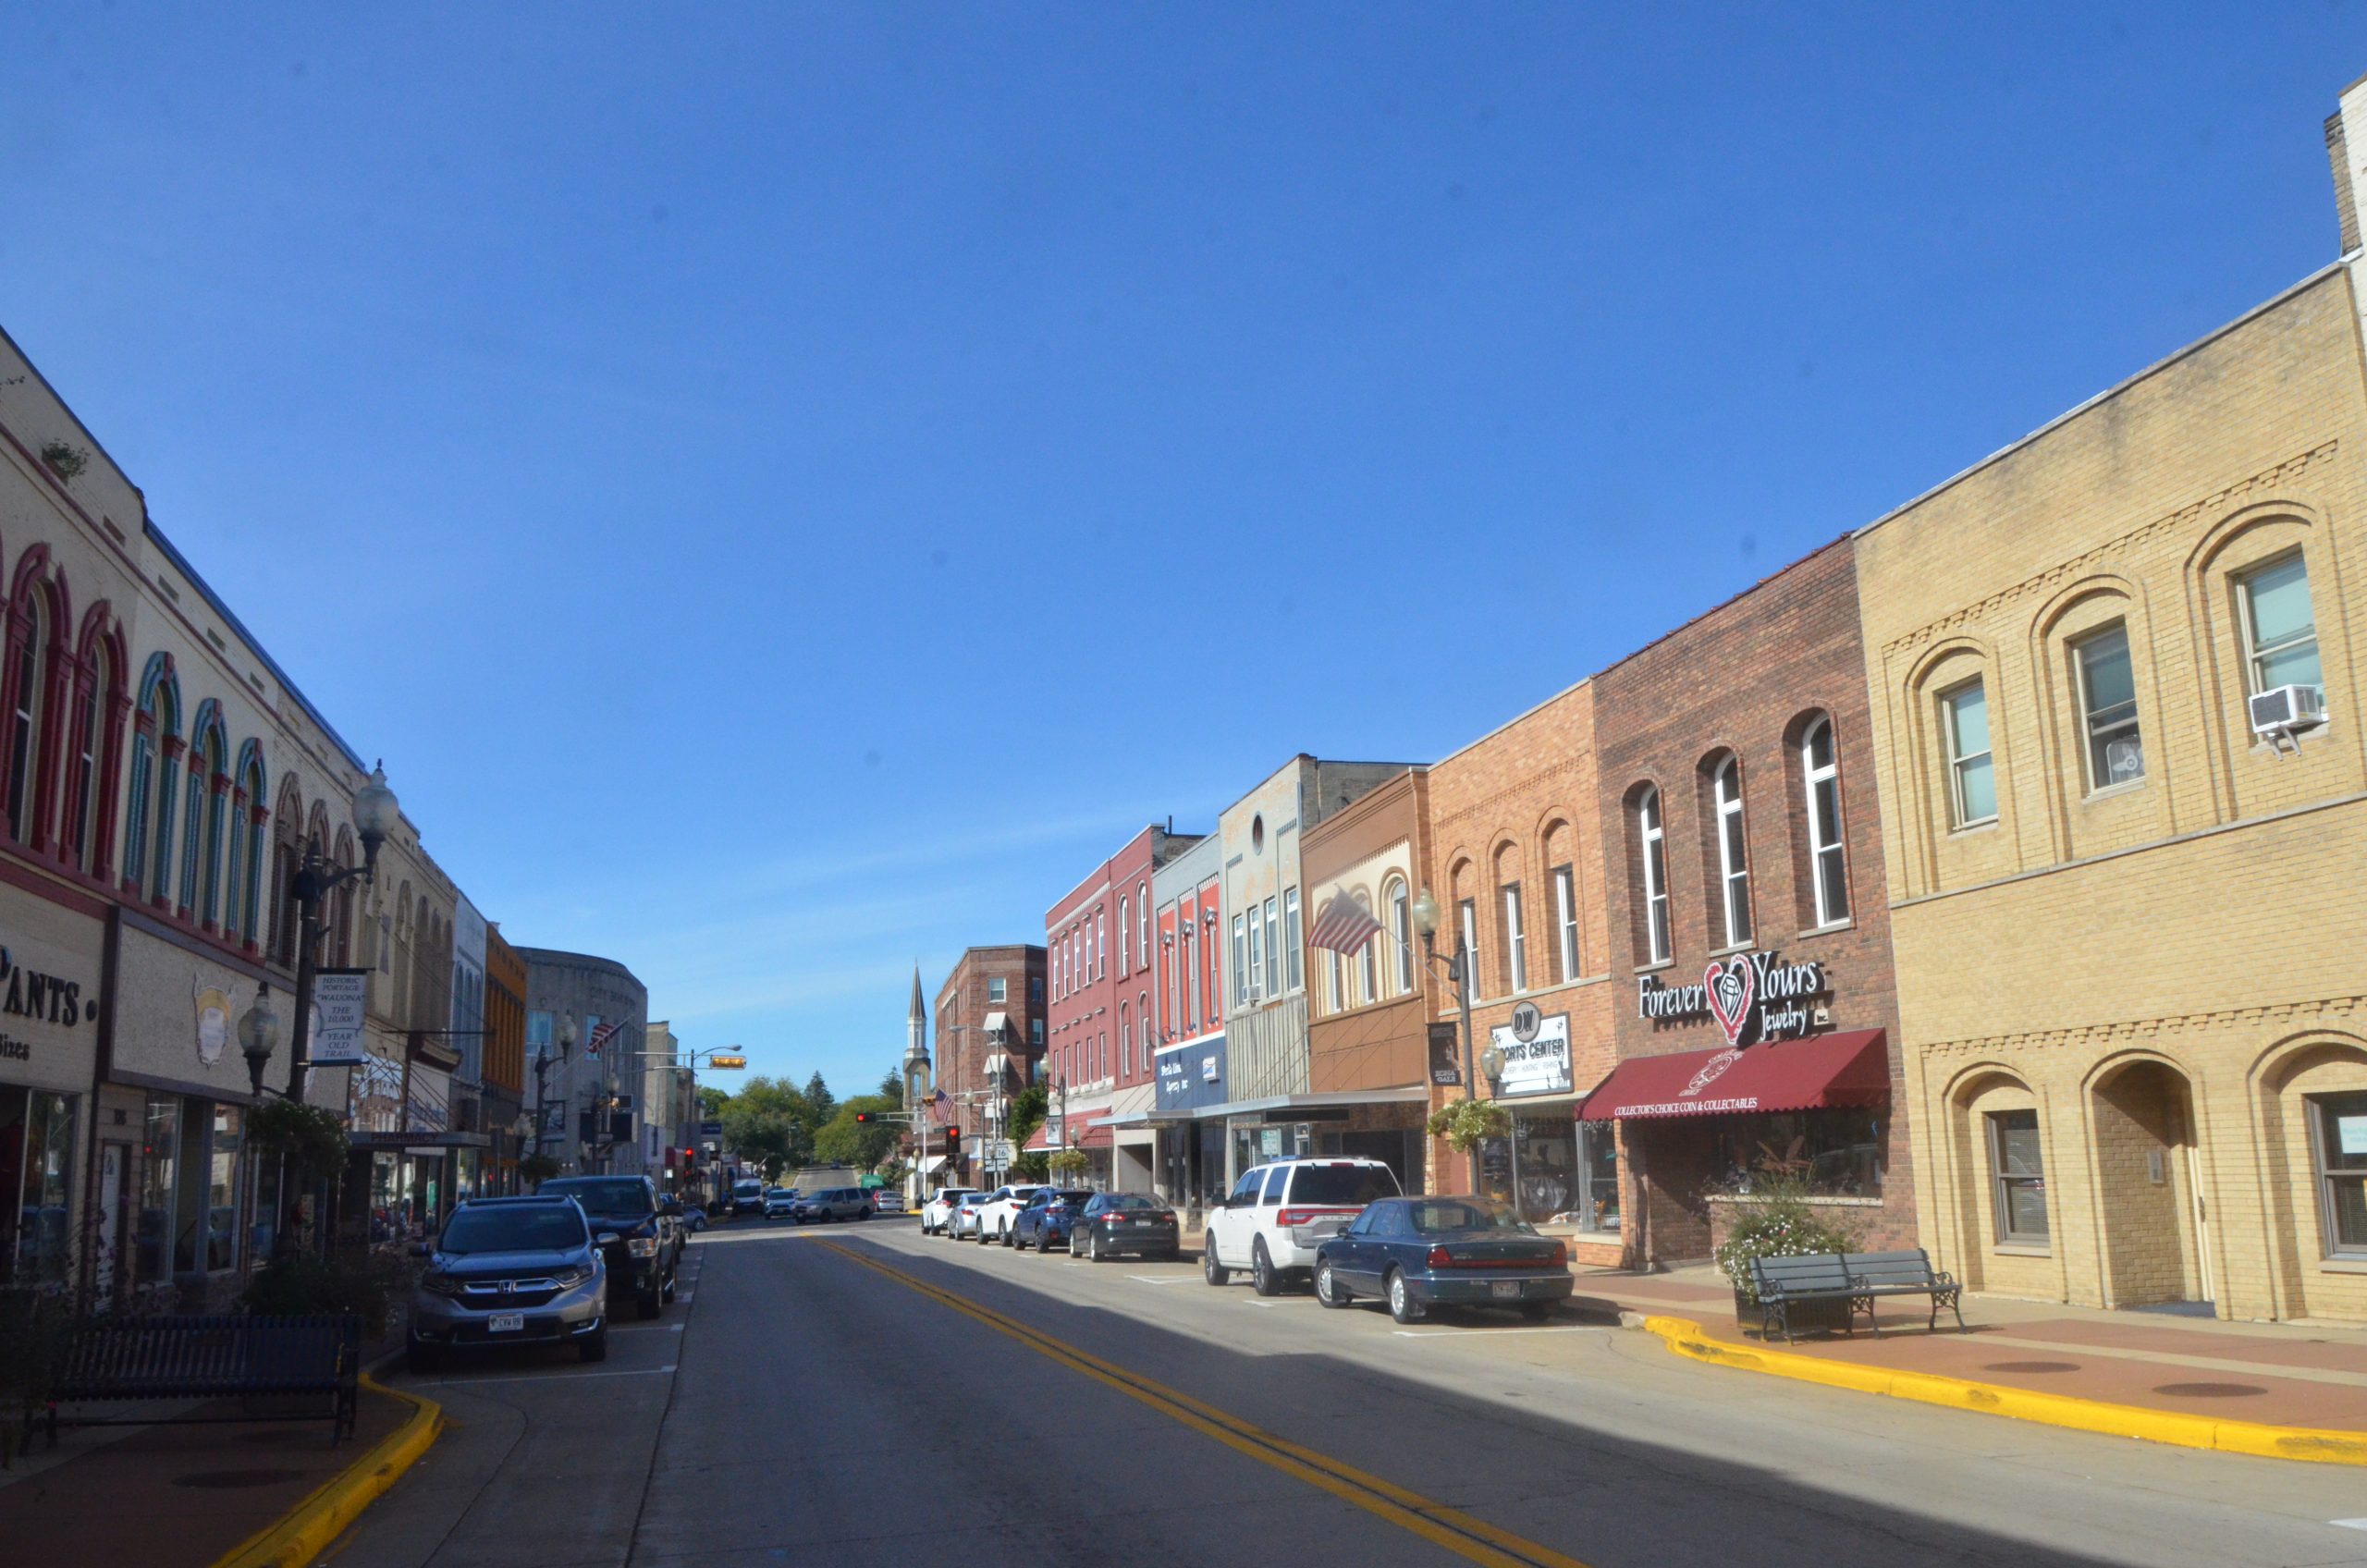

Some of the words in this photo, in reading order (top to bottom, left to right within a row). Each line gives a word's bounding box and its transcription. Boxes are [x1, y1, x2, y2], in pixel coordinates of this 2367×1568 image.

[0, 945, 80, 1026] ANTS
[1638, 974, 1704, 1018] Forever
[1752, 950, 1818, 1002] Yours
[332, 1006, 350, 1014] THE
[1514, 1010, 1535, 1033] DW
[1760, 1001, 1808, 1041] Jewelry
[0, 1034, 30, 1060] izes
[327, 1033, 352, 1041] YEAR
[328, 1041, 350, 1049] OLD
[1501, 1044, 1527, 1062] ORTS
[1528, 1037, 1564, 1059] CENTER
[1614, 1104, 1655, 1116] COLLECTOR'S
[1654, 1102, 1680, 1114] CHOICE
[1679, 1101, 1699, 1113] COIN
[1697, 1101, 1705, 1111] &
[1703, 1096, 1758, 1110] COLLECTABLES
[371, 1133, 438, 1143] PHARMACY
[998, 1149, 1007, 1158] 16
